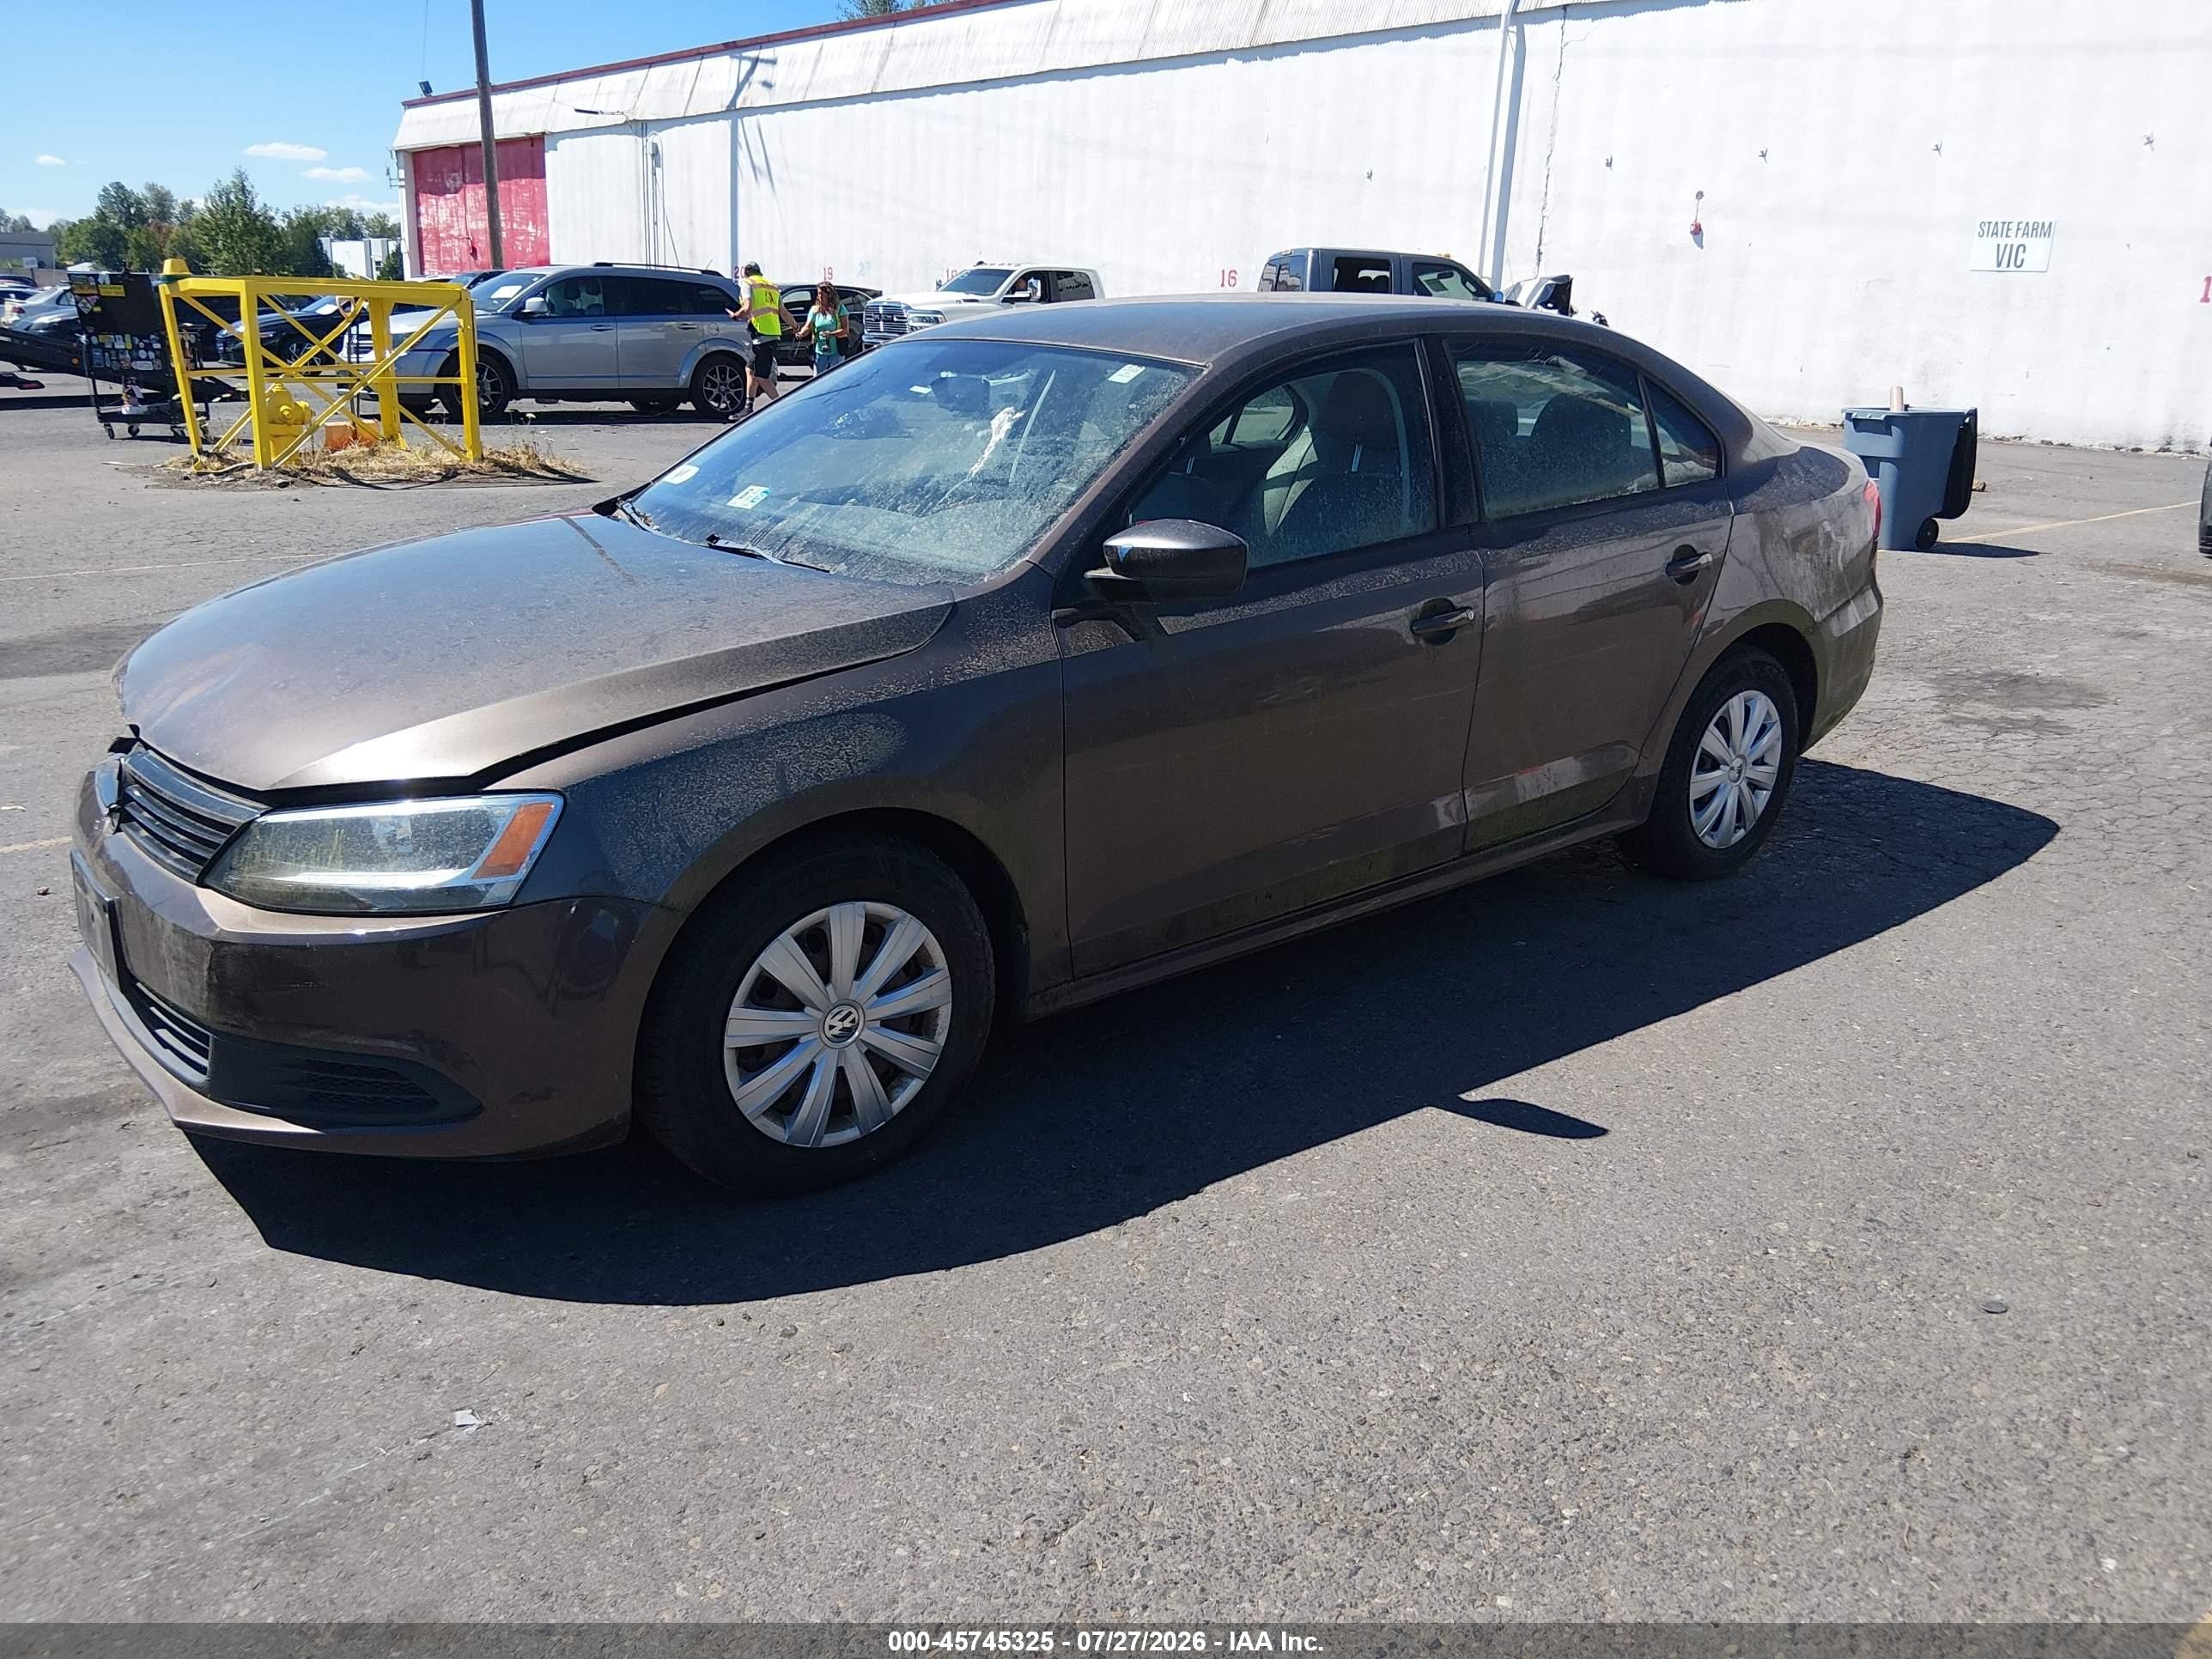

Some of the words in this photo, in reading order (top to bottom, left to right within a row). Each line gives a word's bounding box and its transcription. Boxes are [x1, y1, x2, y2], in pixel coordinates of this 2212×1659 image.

[1978, 221, 2014, 238] STATE
[2014, 221, 2053, 239] FARM
[1996, 243, 2027, 268] VIC
[823, 266, 833, 281] 19
[1220, 269, 1237, 288] 16
